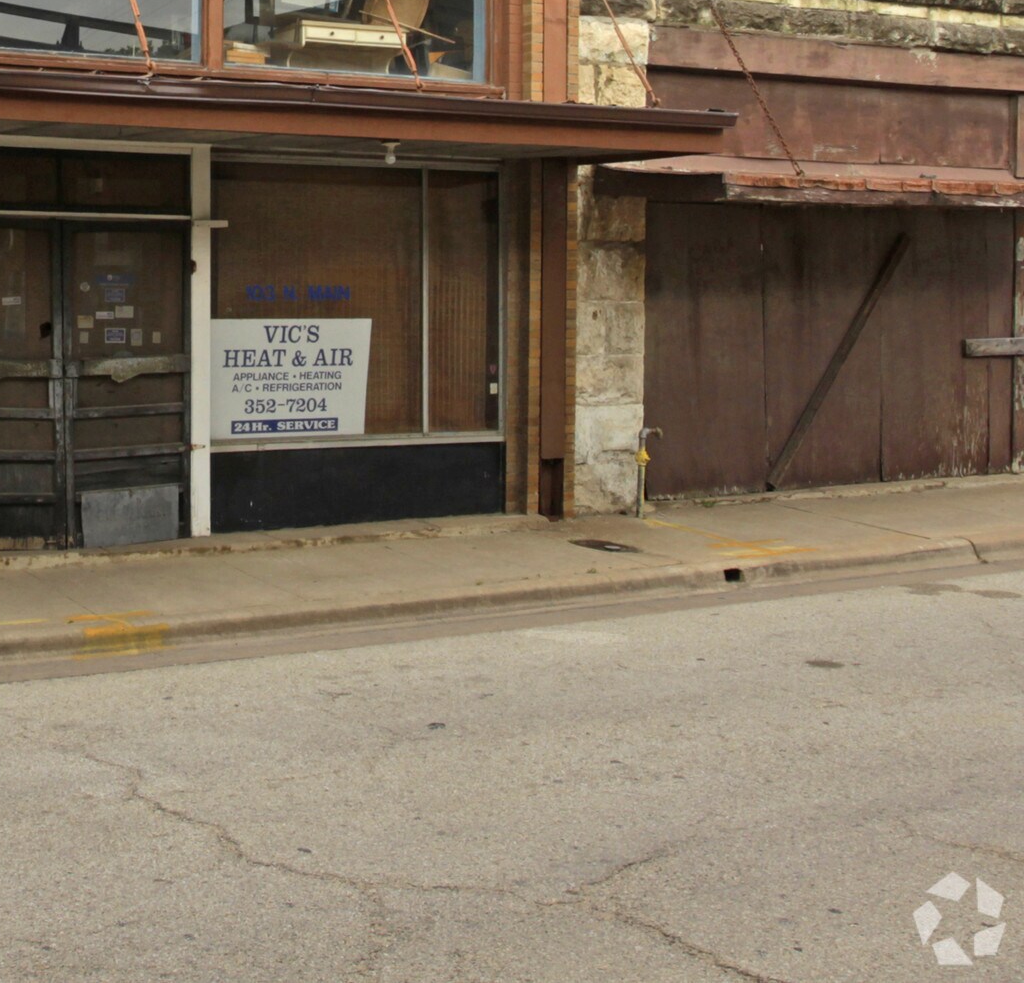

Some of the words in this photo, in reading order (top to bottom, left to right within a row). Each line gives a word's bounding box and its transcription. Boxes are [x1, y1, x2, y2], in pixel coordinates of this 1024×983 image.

[264, 325, 320, 343] VIC'S
[222, 349, 286, 368] HEAT
[292, 350, 307, 367] &
[313, 348, 353, 367] AIR
[233, 372, 289, 382] APPLIANCE
[299, 371, 342, 380] HEATING
[232, 383, 252, 393] A/C
[262, 382, 342, 392] REFRIGERATION
[244, 397, 327, 414] 352-7204
[234, 421, 252, 433] 24
[277, 419, 336, 431] SERVICE
